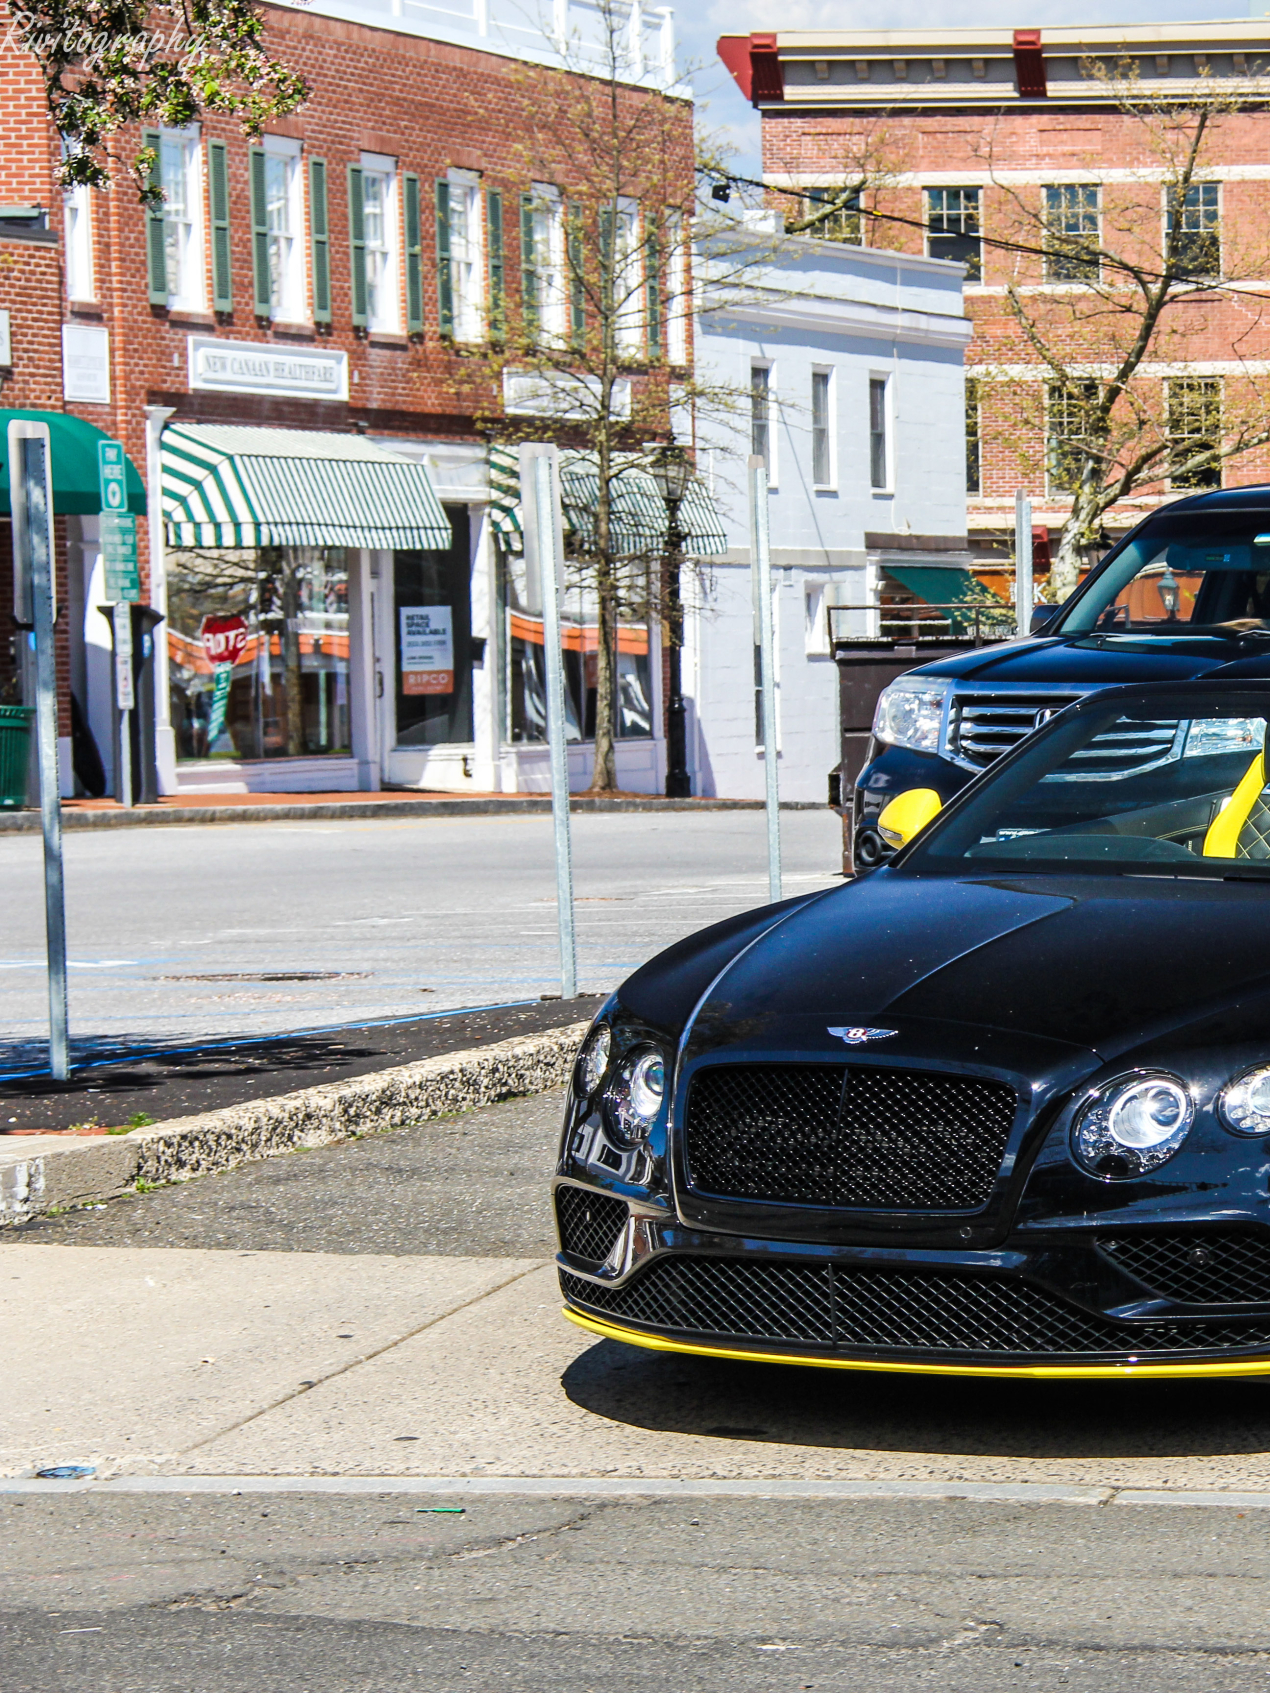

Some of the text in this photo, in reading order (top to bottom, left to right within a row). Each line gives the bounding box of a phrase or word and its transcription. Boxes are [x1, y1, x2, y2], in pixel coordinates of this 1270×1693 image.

[204, 354, 335, 383] NEW CANAAN HEALTHFARE
[408, 673, 449, 684] RIPCO
